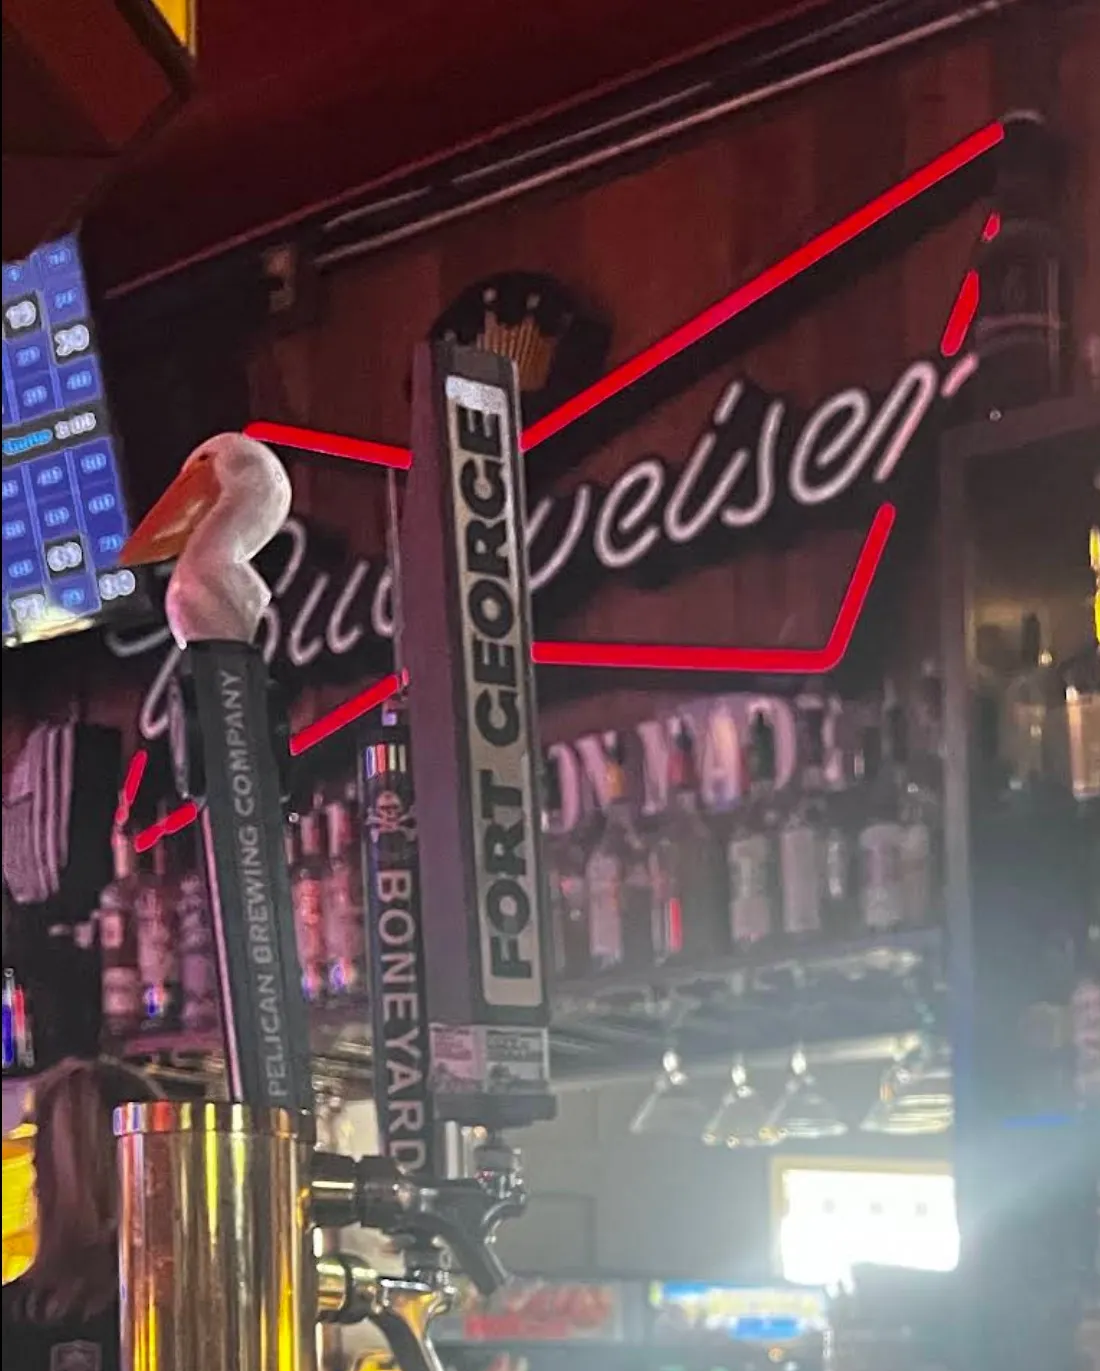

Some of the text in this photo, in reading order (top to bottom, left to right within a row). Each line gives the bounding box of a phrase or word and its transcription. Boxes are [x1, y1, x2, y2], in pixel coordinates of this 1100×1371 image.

[107, 353, 977, 740] uweiser
[456, 402, 521, 747] GEORGE
[220, 670, 289, 1097] PELICAN BREWING COMPANY
[376, 869, 427, 1176] BONEYARD
[476, 768, 533, 980] FORT
